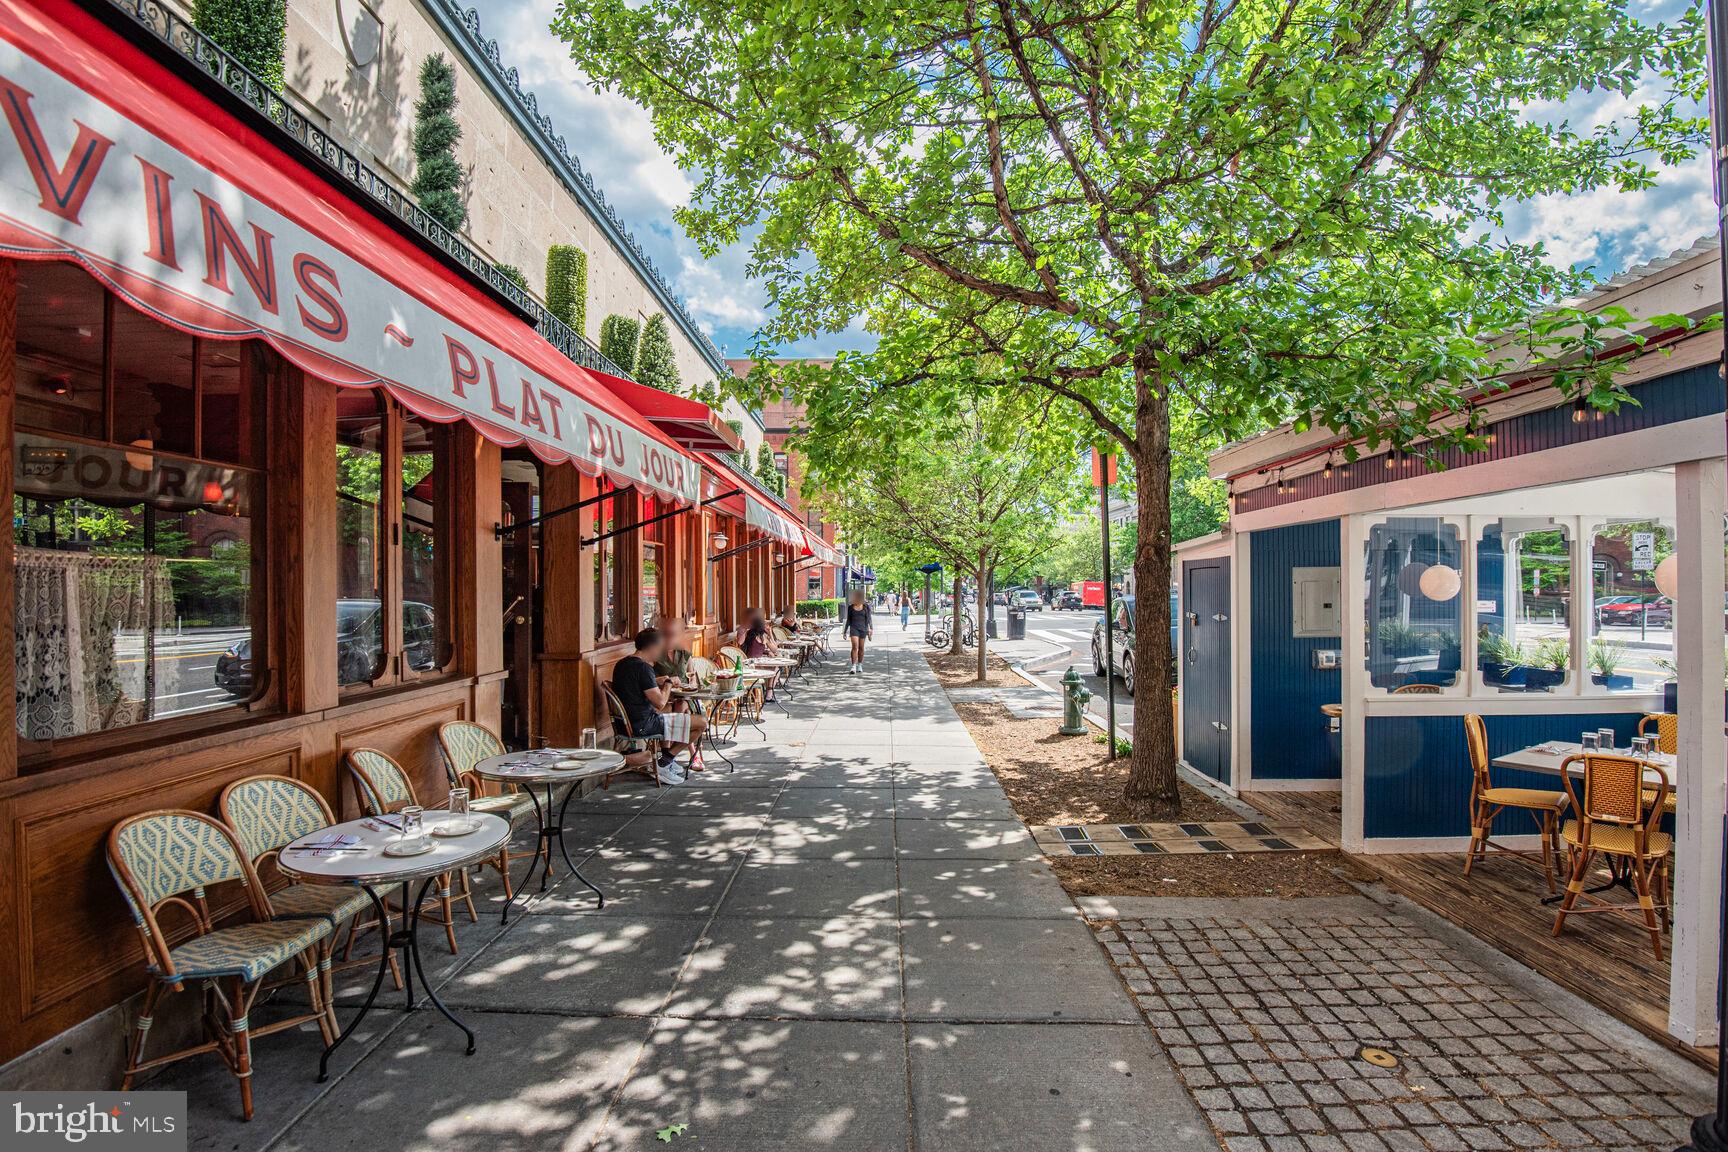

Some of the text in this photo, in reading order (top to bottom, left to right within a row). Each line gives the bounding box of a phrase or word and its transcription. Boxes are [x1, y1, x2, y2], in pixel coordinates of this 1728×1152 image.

[0, 75, 685, 493] VINS PLAT DU JOUR
